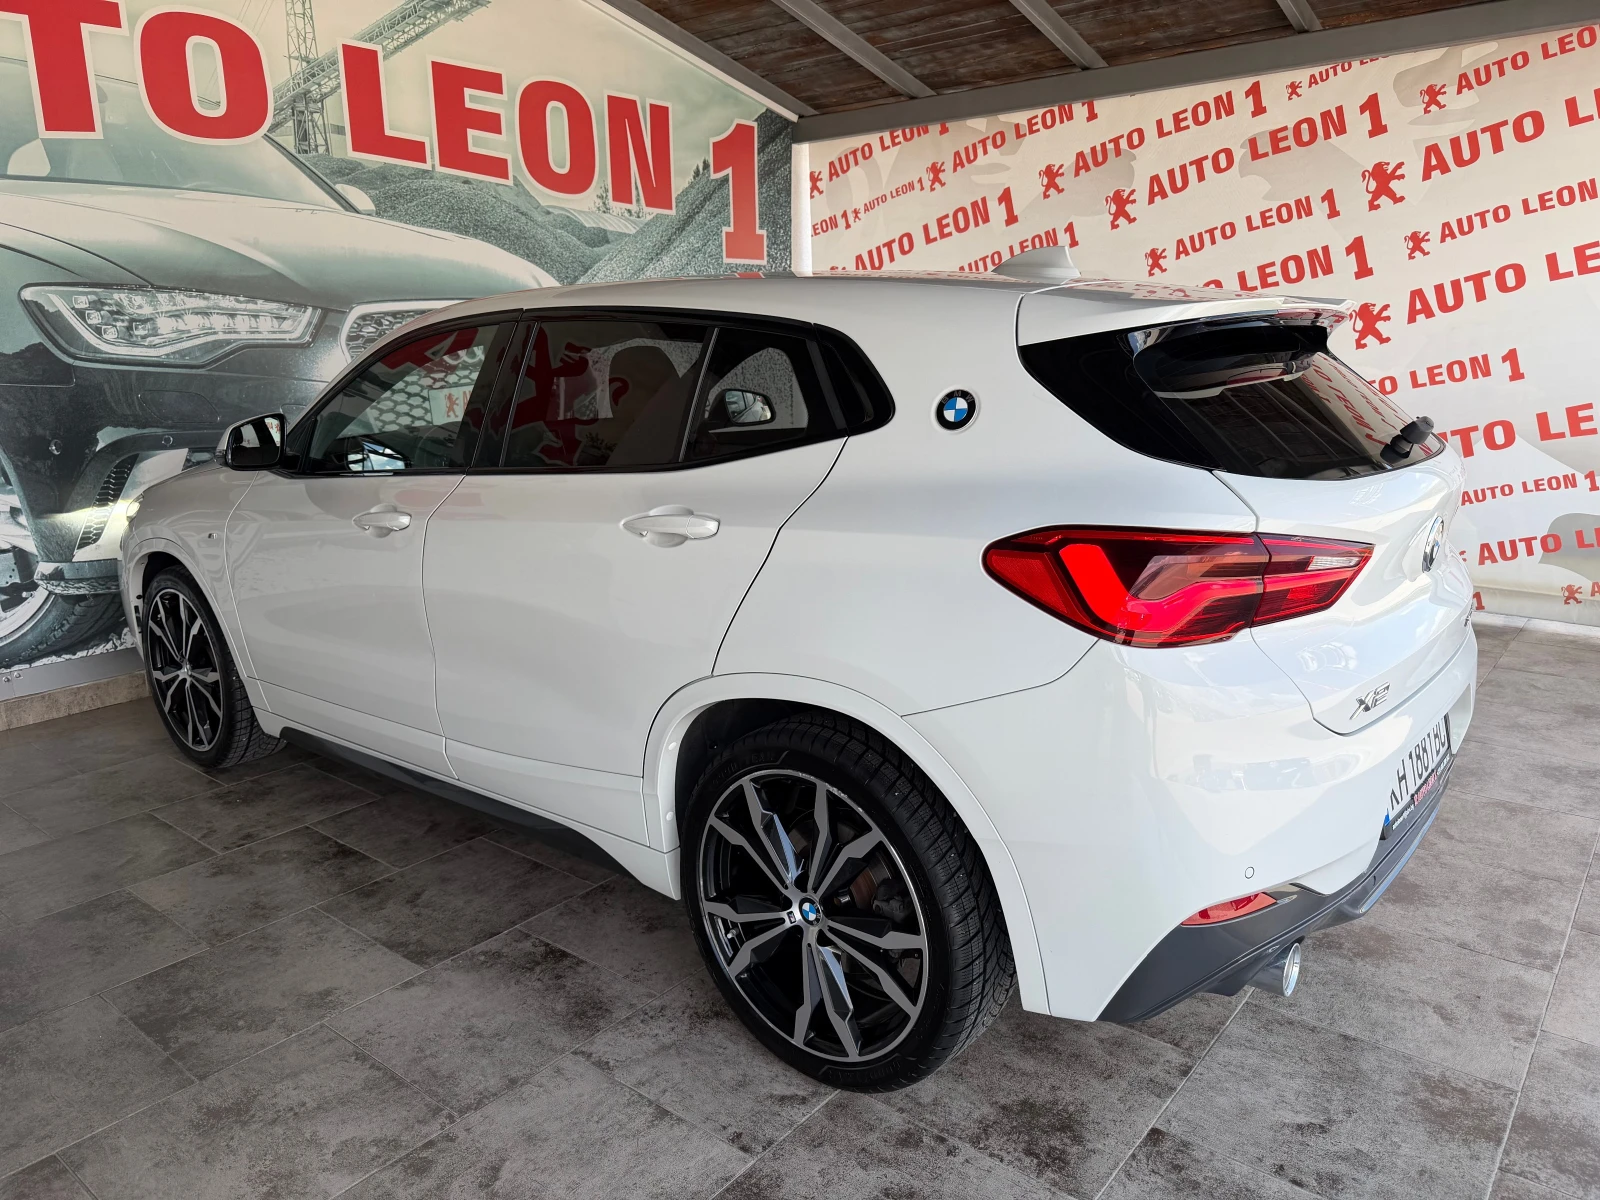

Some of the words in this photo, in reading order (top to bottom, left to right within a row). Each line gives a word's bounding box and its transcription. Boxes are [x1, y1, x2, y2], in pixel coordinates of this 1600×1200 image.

[1308, 60, 1354, 89] AUTO
[1456, 49, 1532, 96] AUTO
[1540, 23, 1600, 61] LEO
[339, 41, 675, 213] LEON
[710, 121, 766, 263] 1
[952, 129, 1007, 174] AUTO
[1014, 104, 1075, 141] LEON
[1080, 99, 1099, 123] 1
[1073, 126, 1146, 179] AUTO
[1154, 89, 1236, 140] LEON
[1243, 79, 1268, 119] 1
[1147, 146, 1236, 207] AUTO
[1247, 104, 1348, 163] LEON
[1358, 91, 1390, 140] 1
[1421, 109, 1546, 183] AUTO
[1563, 87, 1600, 128] L
[827, 141, 874, 183] AUTO
[811, 214, 839, 237] EON
[840, 209, 852, 231] 1
[863, 193, 888, 214] AUTO
[889, 180, 916, 199] LEON
[917, 176, 926, 192] 1
[1439, 203, 1512, 244] AUTO
[1521, 177, 1599, 216] LEON
[854, 231, 915, 271] AUTO
[921, 195, 991, 246] LEON
[996, 186, 1020, 228] 1
[1063, 221, 1080, 249] 1
[1174, 220, 1238, 261] AUTO
[1244, 195, 1314, 233] LEON
[1319, 187, 1342, 221] 1
[1236, 244, 1335, 293] LEON
[1344, 235, 1375, 281] 1
[1406, 262, 1527, 325] AUTO
[1544, 240, 1600, 282] LE
[1408, 353, 1493, 391] LEON
[1500, 347, 1526, 383] 1
[1436, 419, 1517, 459] TO
[1535, 402, 1599, 442] LE
[1461, 483, 1515, 506] AUTO
[1521, 473, 1578, 494] LEON
[1583, 469, 1600, 493] 1
[1478, 533, 1563, 566] AUTO
[1472, 591, 1485, 611] 1
[1349, 681, 1391, 720] X2
